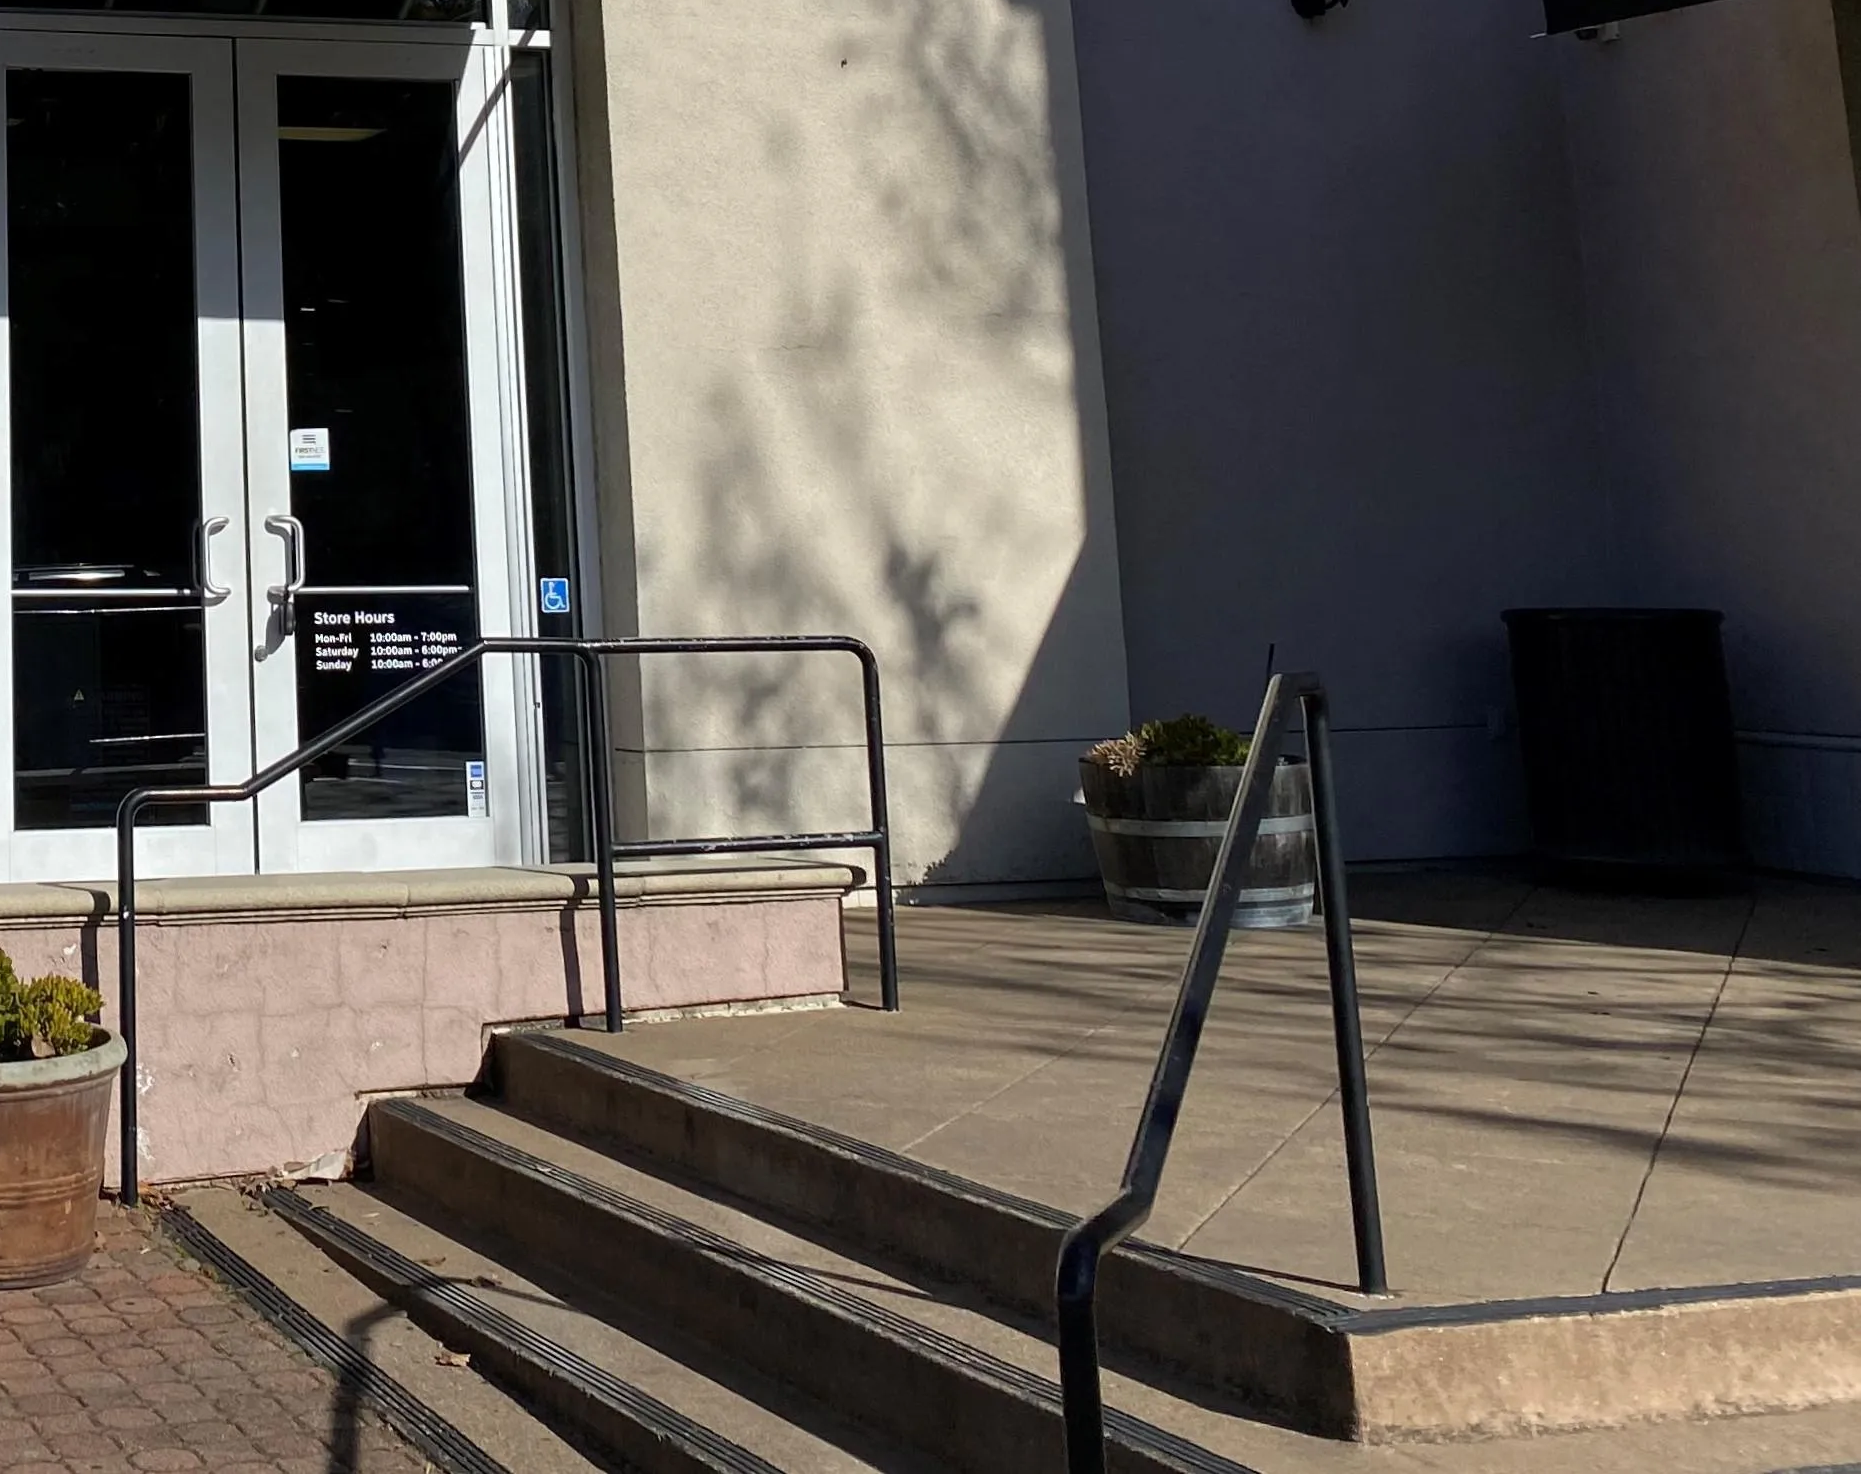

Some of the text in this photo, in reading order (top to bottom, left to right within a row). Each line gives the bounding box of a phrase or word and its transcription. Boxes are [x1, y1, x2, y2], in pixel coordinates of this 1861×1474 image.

[314, 610, 395, 625] Store Hours
[314, 632, 353, 644] Mon-Fri
[370, 632, 412, 643] 10:00am
[420, 631, 457, 644] 7:00pm
[315, 646, 359, 658] Saturday
[370, 646, 413, 656] 10:00am
[316, 659, 353, 672] Sunday
[371, 659, 414, 669] 10:00am
